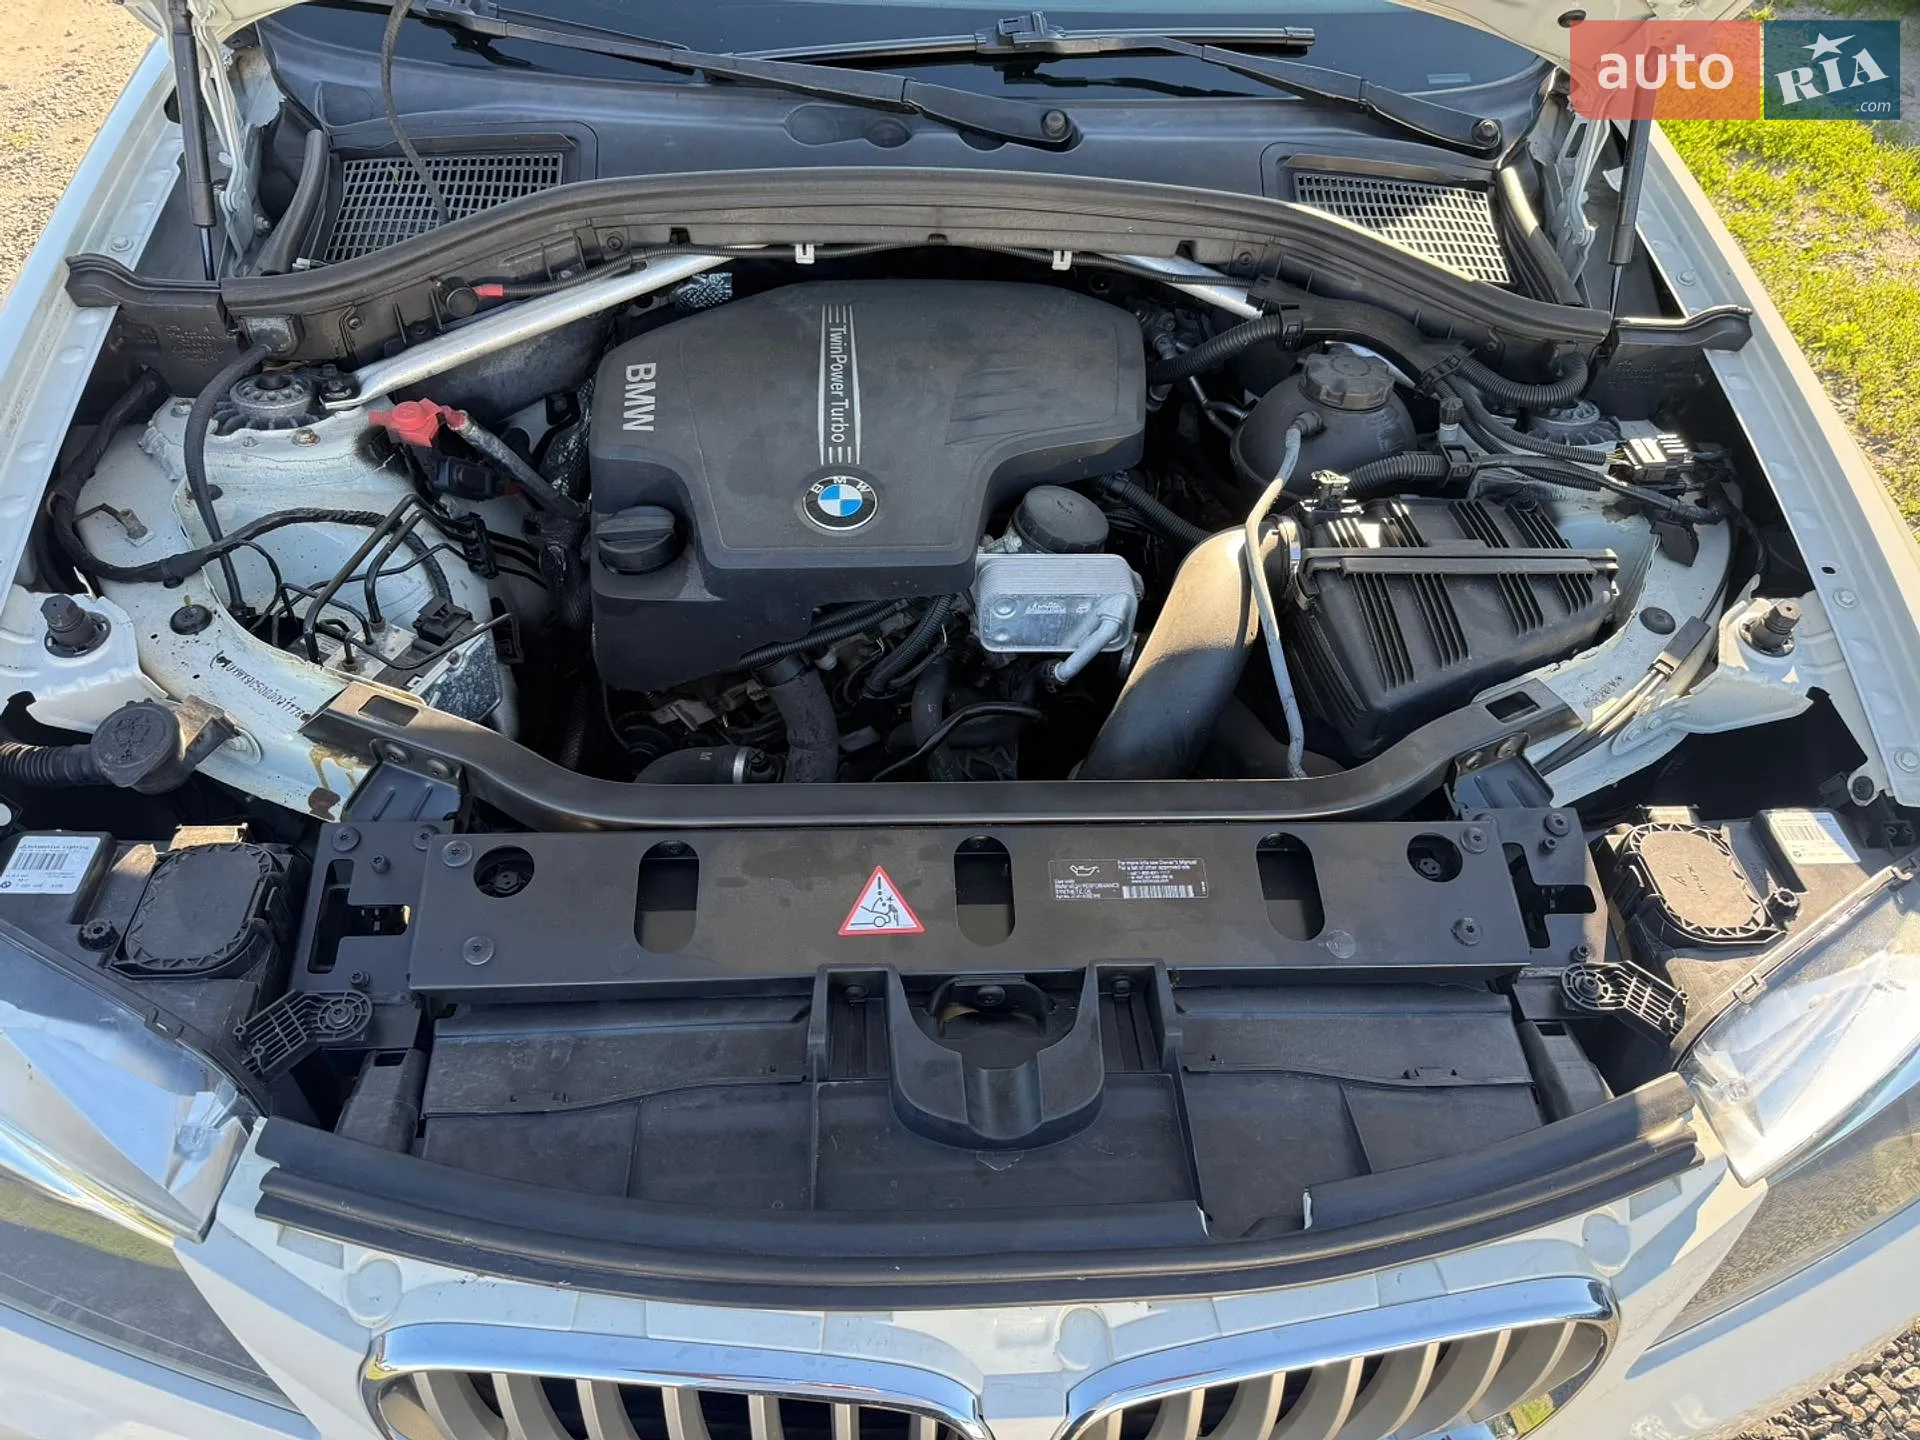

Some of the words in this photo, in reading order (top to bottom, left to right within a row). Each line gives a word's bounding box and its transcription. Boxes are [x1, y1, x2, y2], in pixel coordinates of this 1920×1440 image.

[829, 325, 848, 397] TwinPower
[622, 362, 657, 431] BMW
[830, 398, 849, 443] Turbo
[810, 476, 872, 493] BMW
